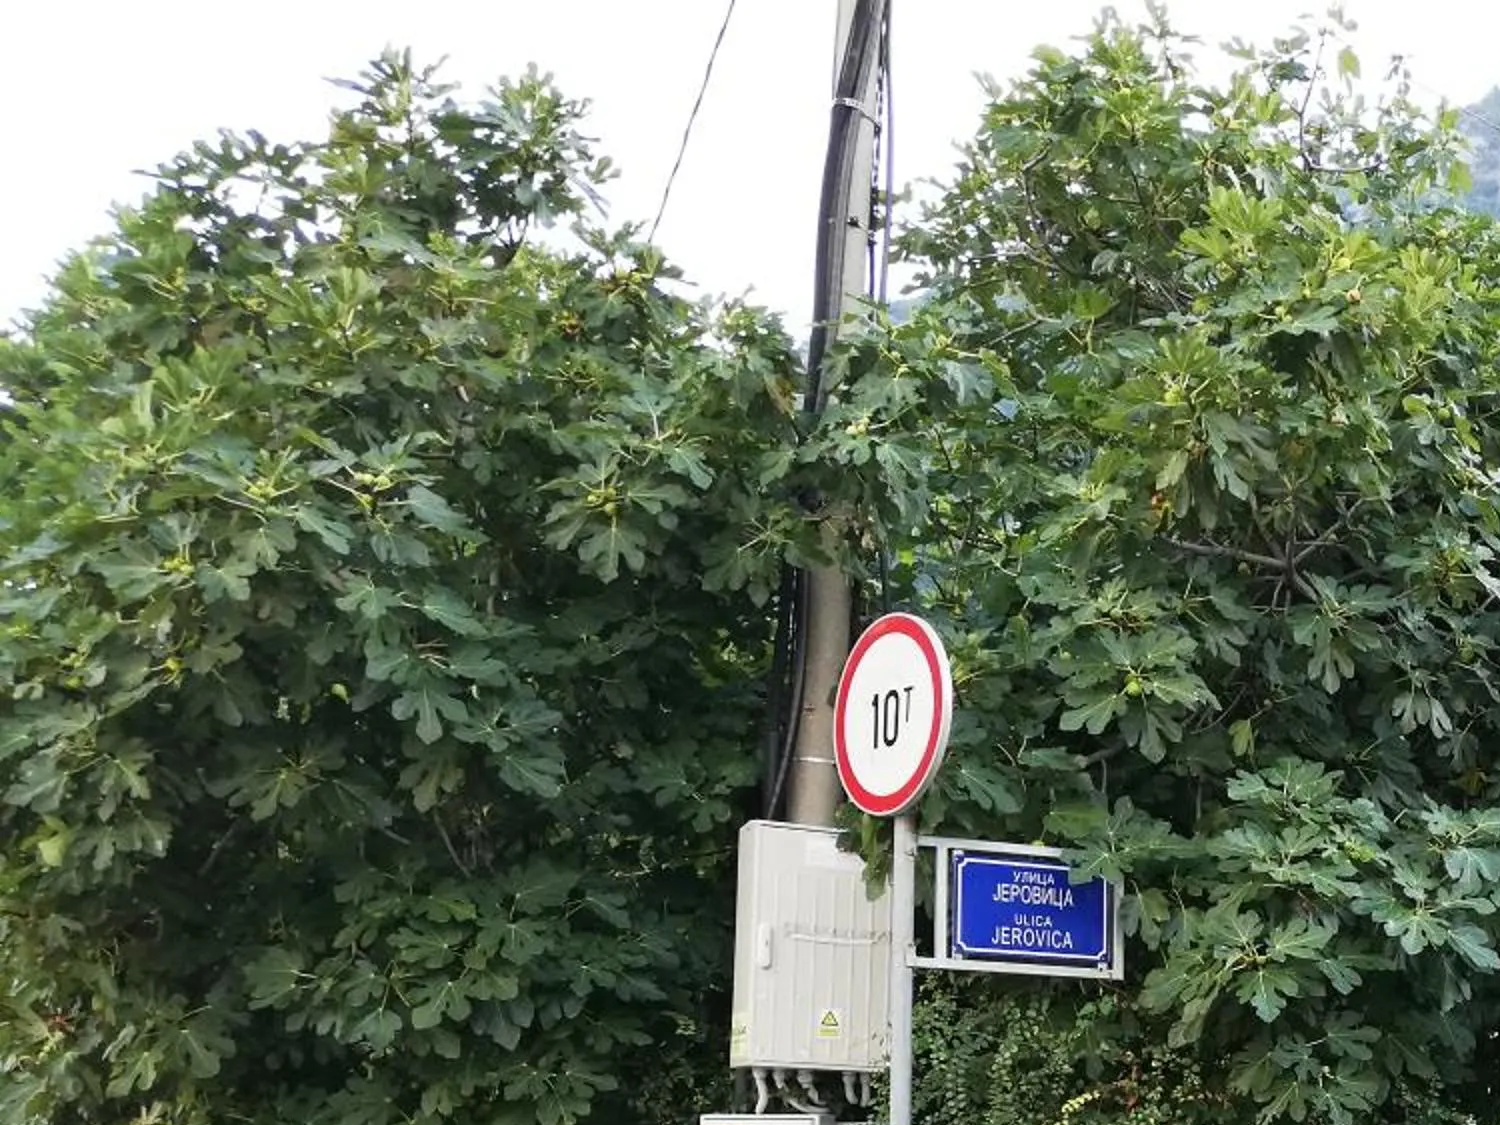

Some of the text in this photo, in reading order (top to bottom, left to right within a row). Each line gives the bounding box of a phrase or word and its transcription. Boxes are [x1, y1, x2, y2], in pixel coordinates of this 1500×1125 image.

[1013, 871, 1055, 886] УЛИЦА
[992, 883, 1075, 910] ЈЕРОВИЦА
[1014, 913, 1052, 928] ULICA
[991, 926, 1073, 949] JEROVICA
